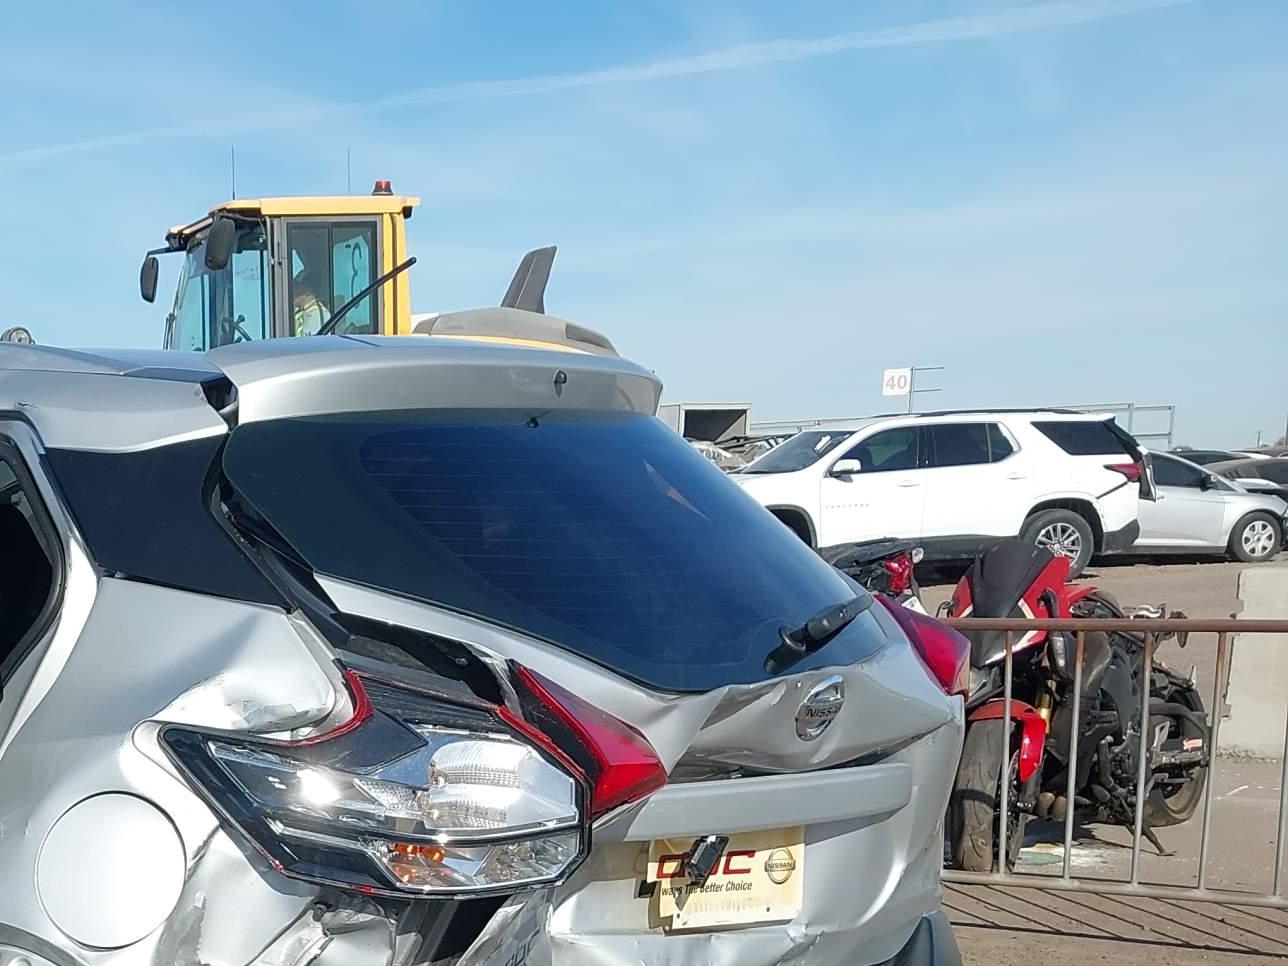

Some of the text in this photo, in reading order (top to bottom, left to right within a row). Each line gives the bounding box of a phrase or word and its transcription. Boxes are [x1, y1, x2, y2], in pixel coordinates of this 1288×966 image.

[885, 374, 908, 391] 40
[699, 882, 724, 895] Better
[725, 880, 753, 892] Choice
